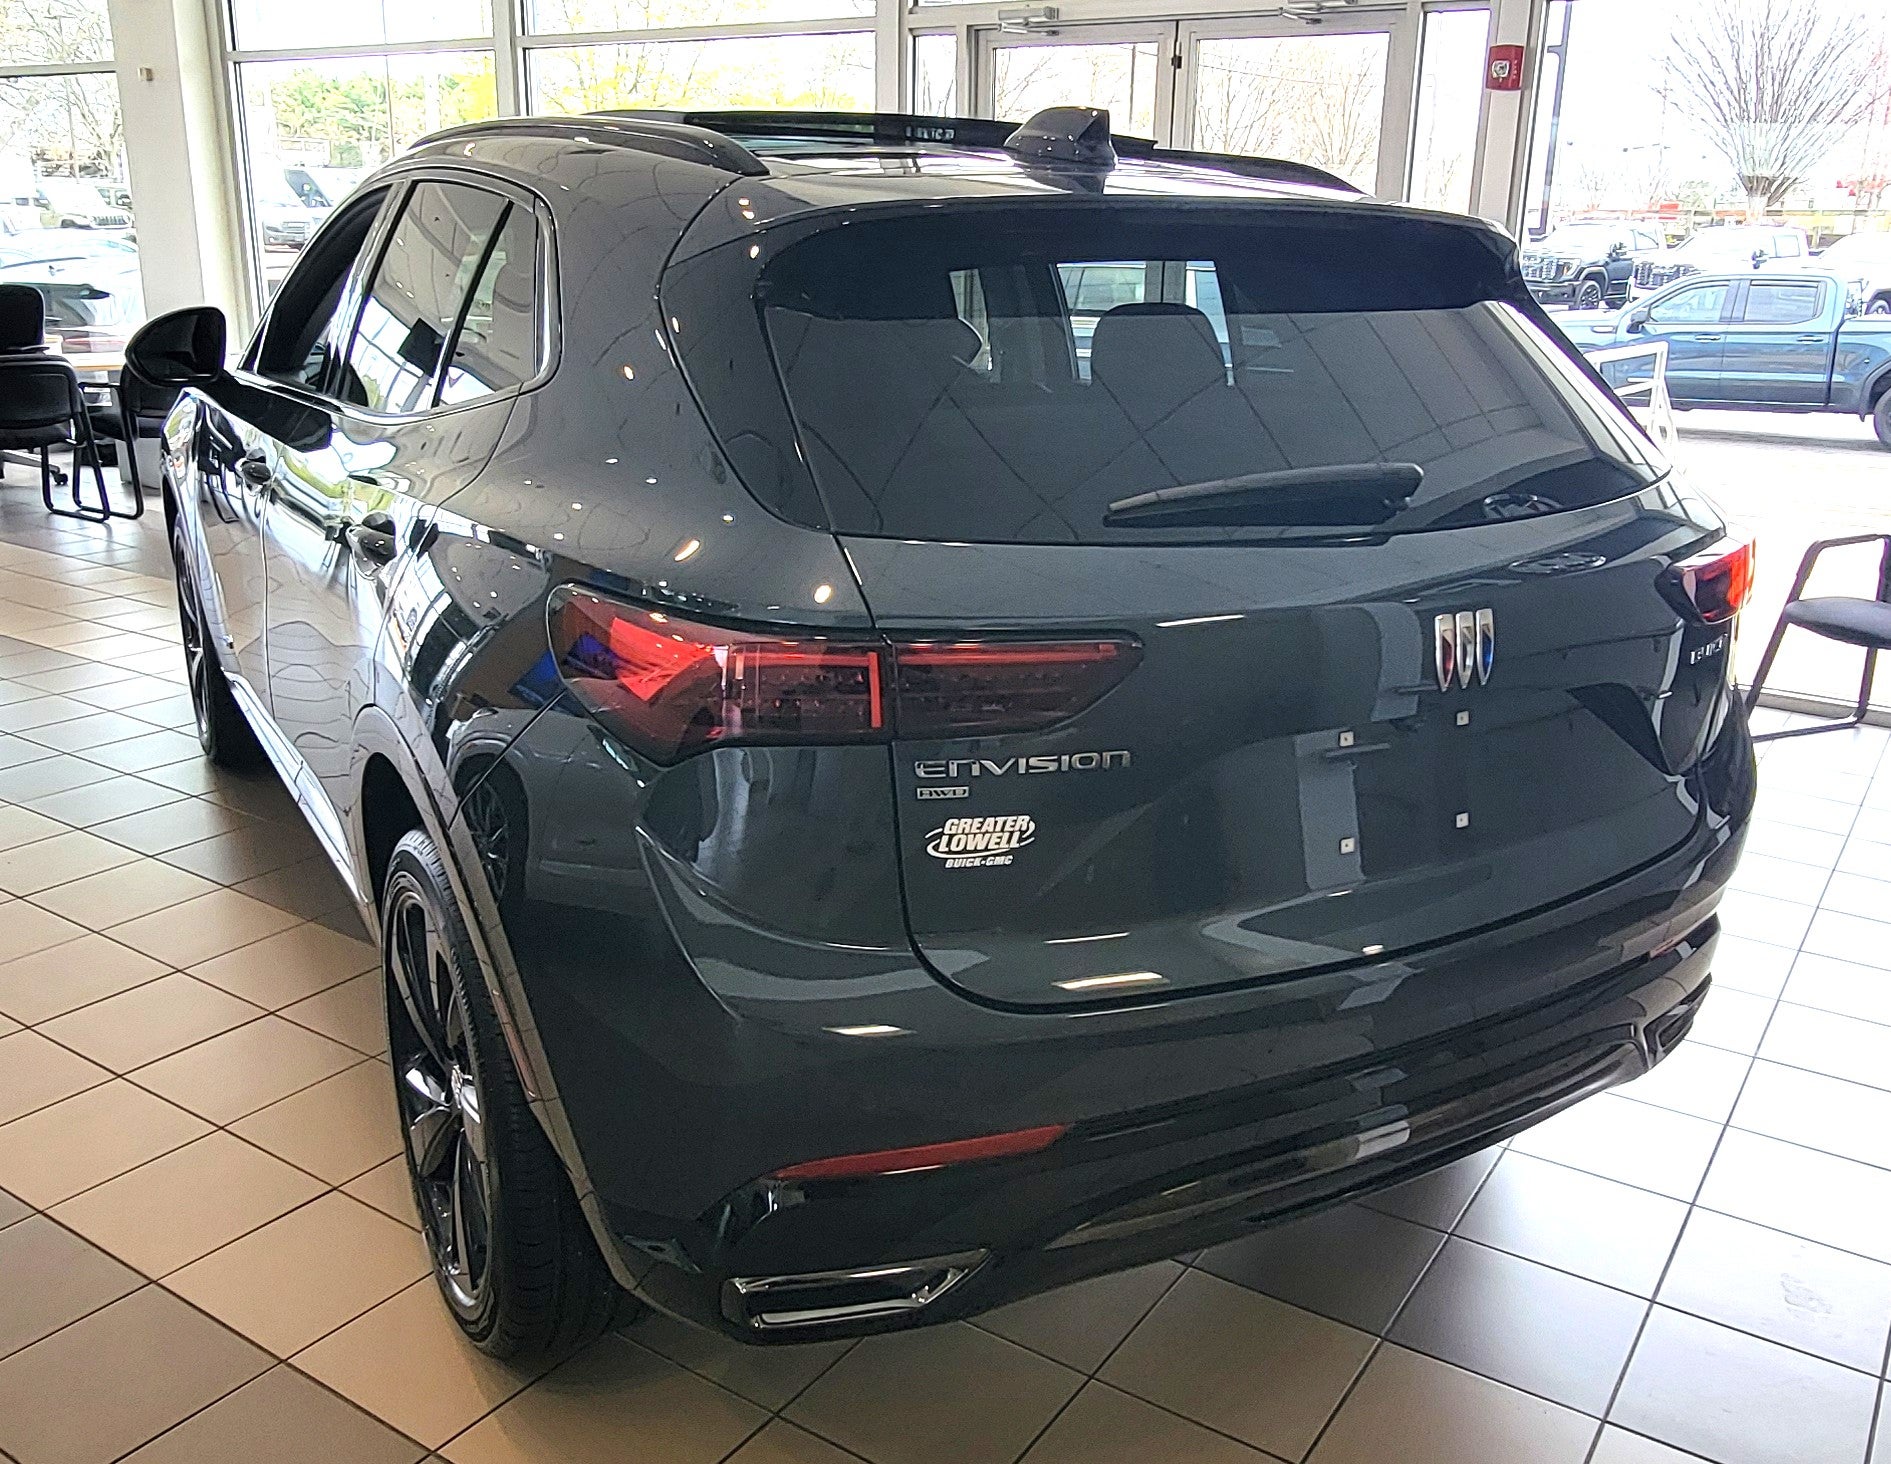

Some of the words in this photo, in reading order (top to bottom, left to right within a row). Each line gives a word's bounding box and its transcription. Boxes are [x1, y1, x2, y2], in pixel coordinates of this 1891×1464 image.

[914, 750, 1131, 778] ENVISION
[917, 787, 969, 799] AWD
[943, 814, 1030, 834] GREATER
[938, 831, 1020, 852] LOWELL
